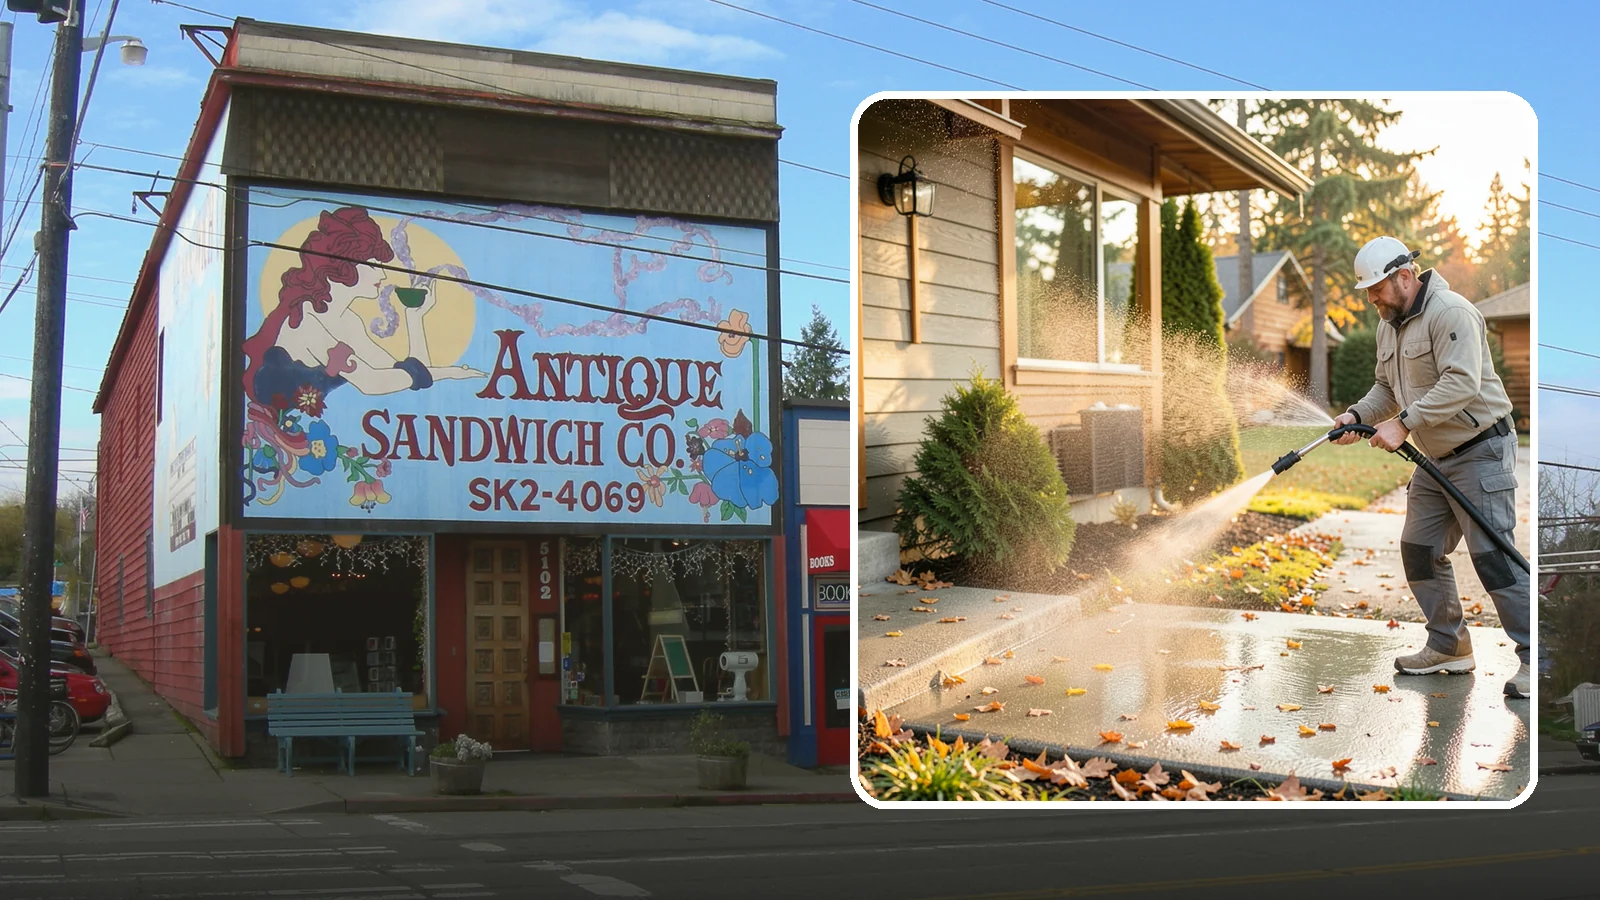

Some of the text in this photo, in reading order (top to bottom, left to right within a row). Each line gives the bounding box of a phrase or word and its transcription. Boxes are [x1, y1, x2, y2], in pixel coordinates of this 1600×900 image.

[475, 329, 723, 421] ANTIQUE
[361, 408, 685, 468] SANDWICH CO.
[469, 477, 646, 513] SK2-4069
[539, 541, 552, 600] 5102
[809, 555, 835, 569] BOOKS
